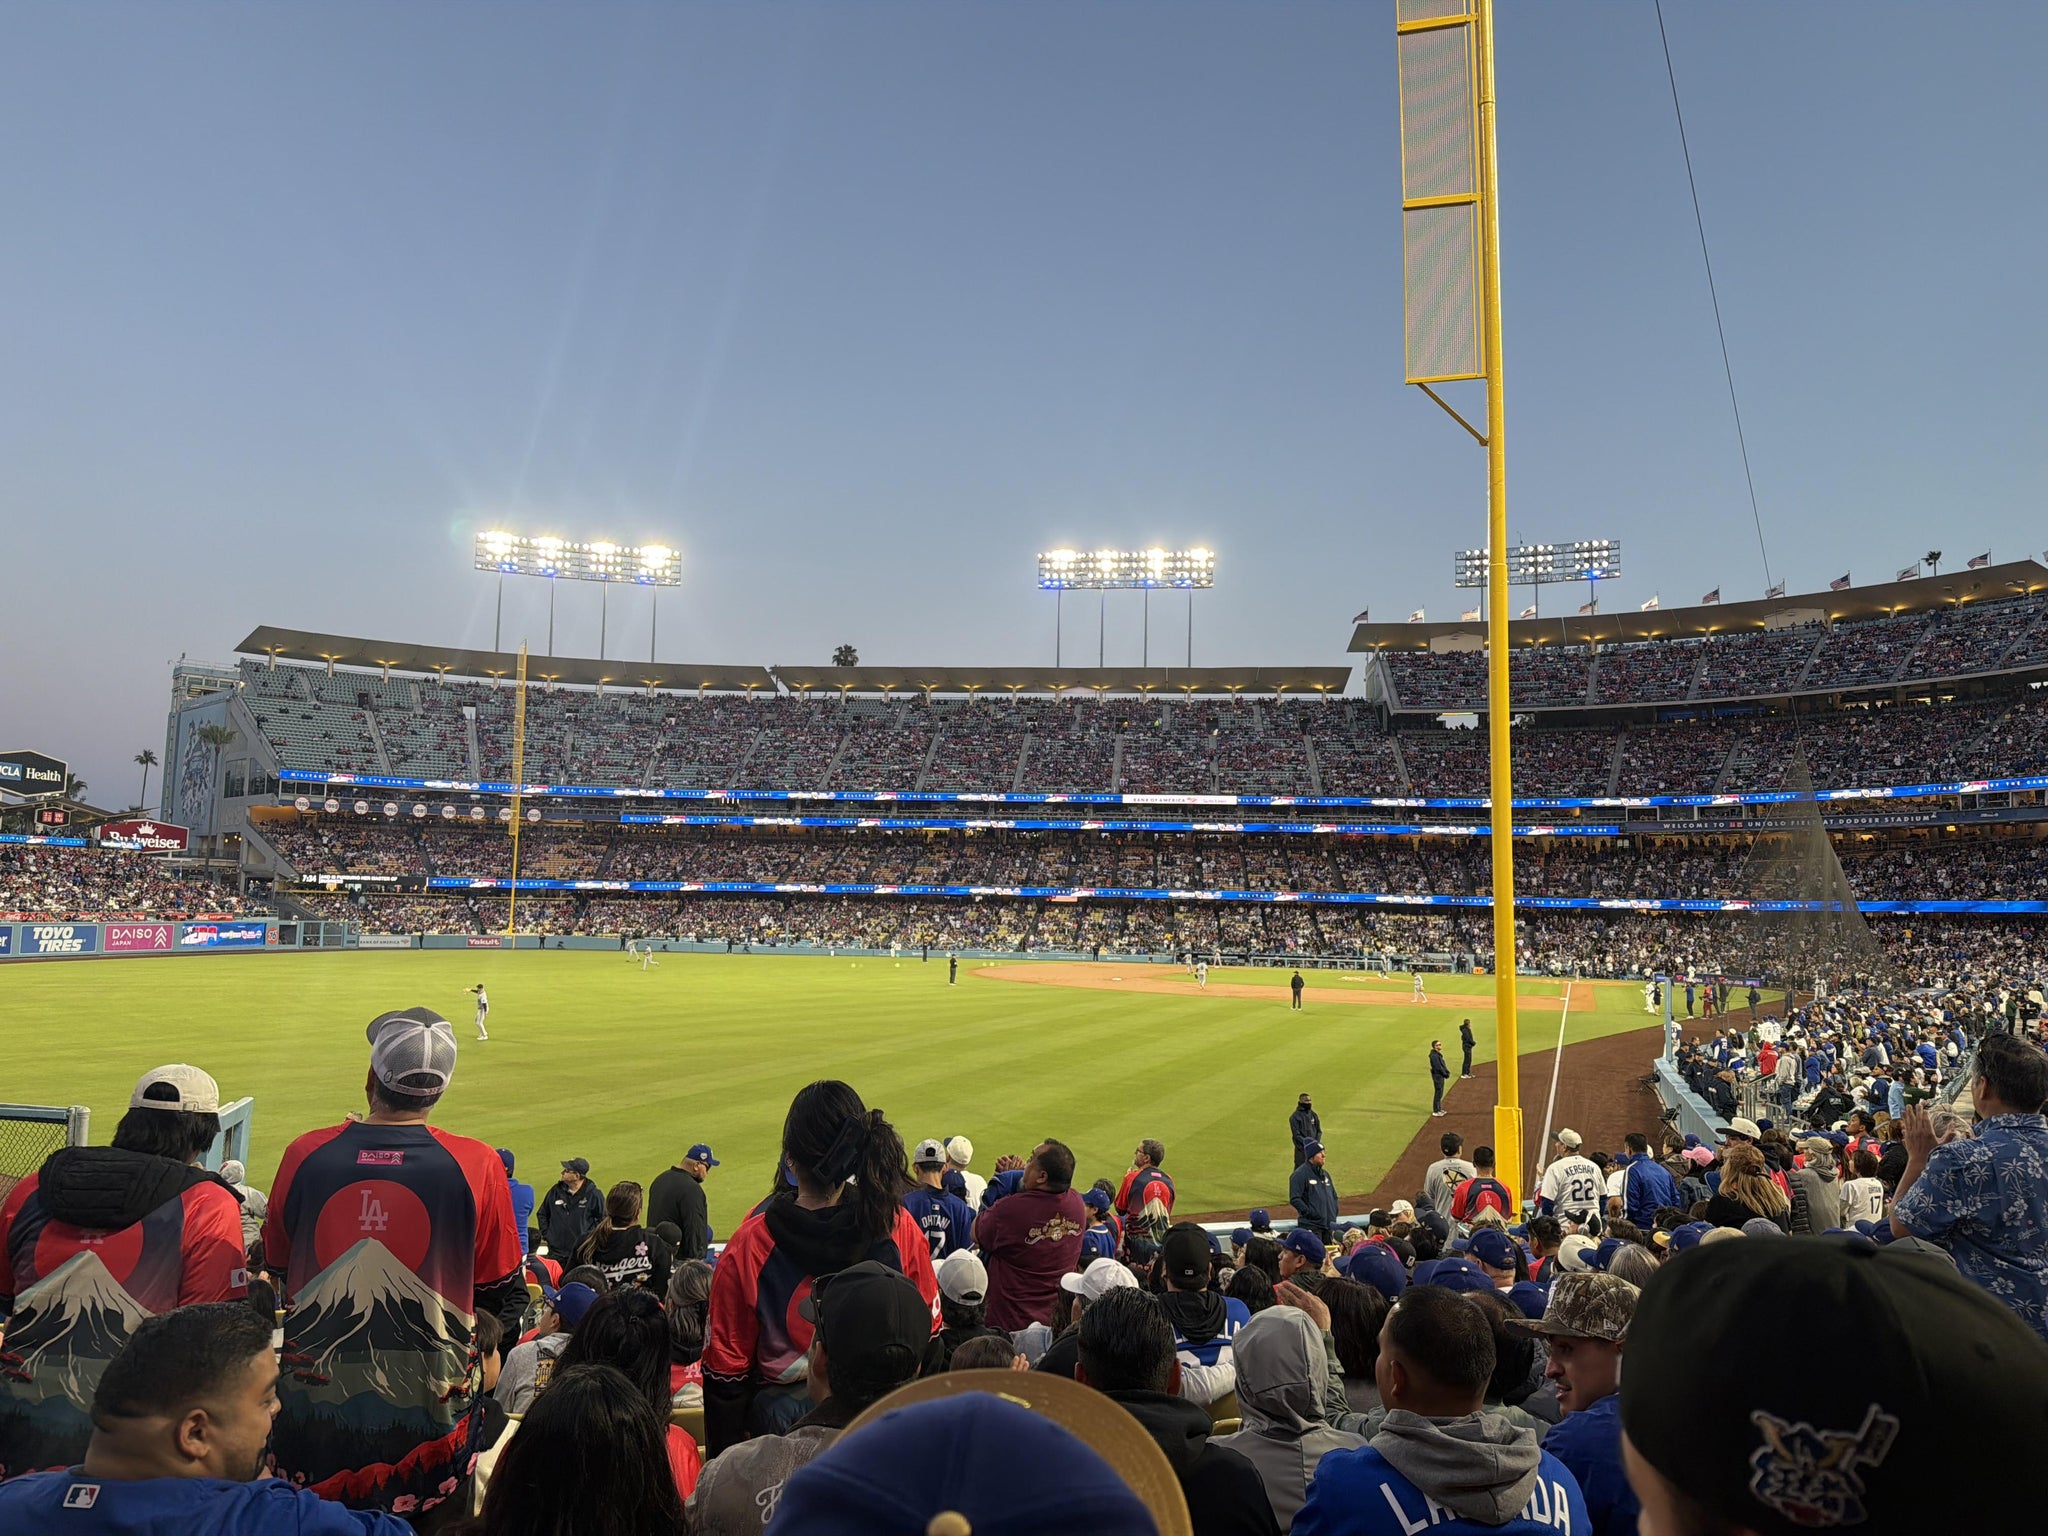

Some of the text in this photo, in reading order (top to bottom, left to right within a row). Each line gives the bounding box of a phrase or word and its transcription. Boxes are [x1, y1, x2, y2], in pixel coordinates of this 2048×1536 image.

[26, 768, 61, 782] Health
[1663, 822, 1708, 830] WELCOME
[1839, 817, 1880, 825] DODGER
[33, 926, 74, 940] TOYO
[112, 928, 152, 939] DAISO
[270, 932, 276, 940] 76
[38, 940, 83, 952] TIRES
[468, 938, 500, 946] Yakult
[1572, 1178, 1594, 1202] 22
[358, 1190, 388, 1230] LA
[1870, 1196, 1880, 1214] 17
[922, 1214, 950, 1230] OHTANI
[599, 1256, 653, 1282] odgers
